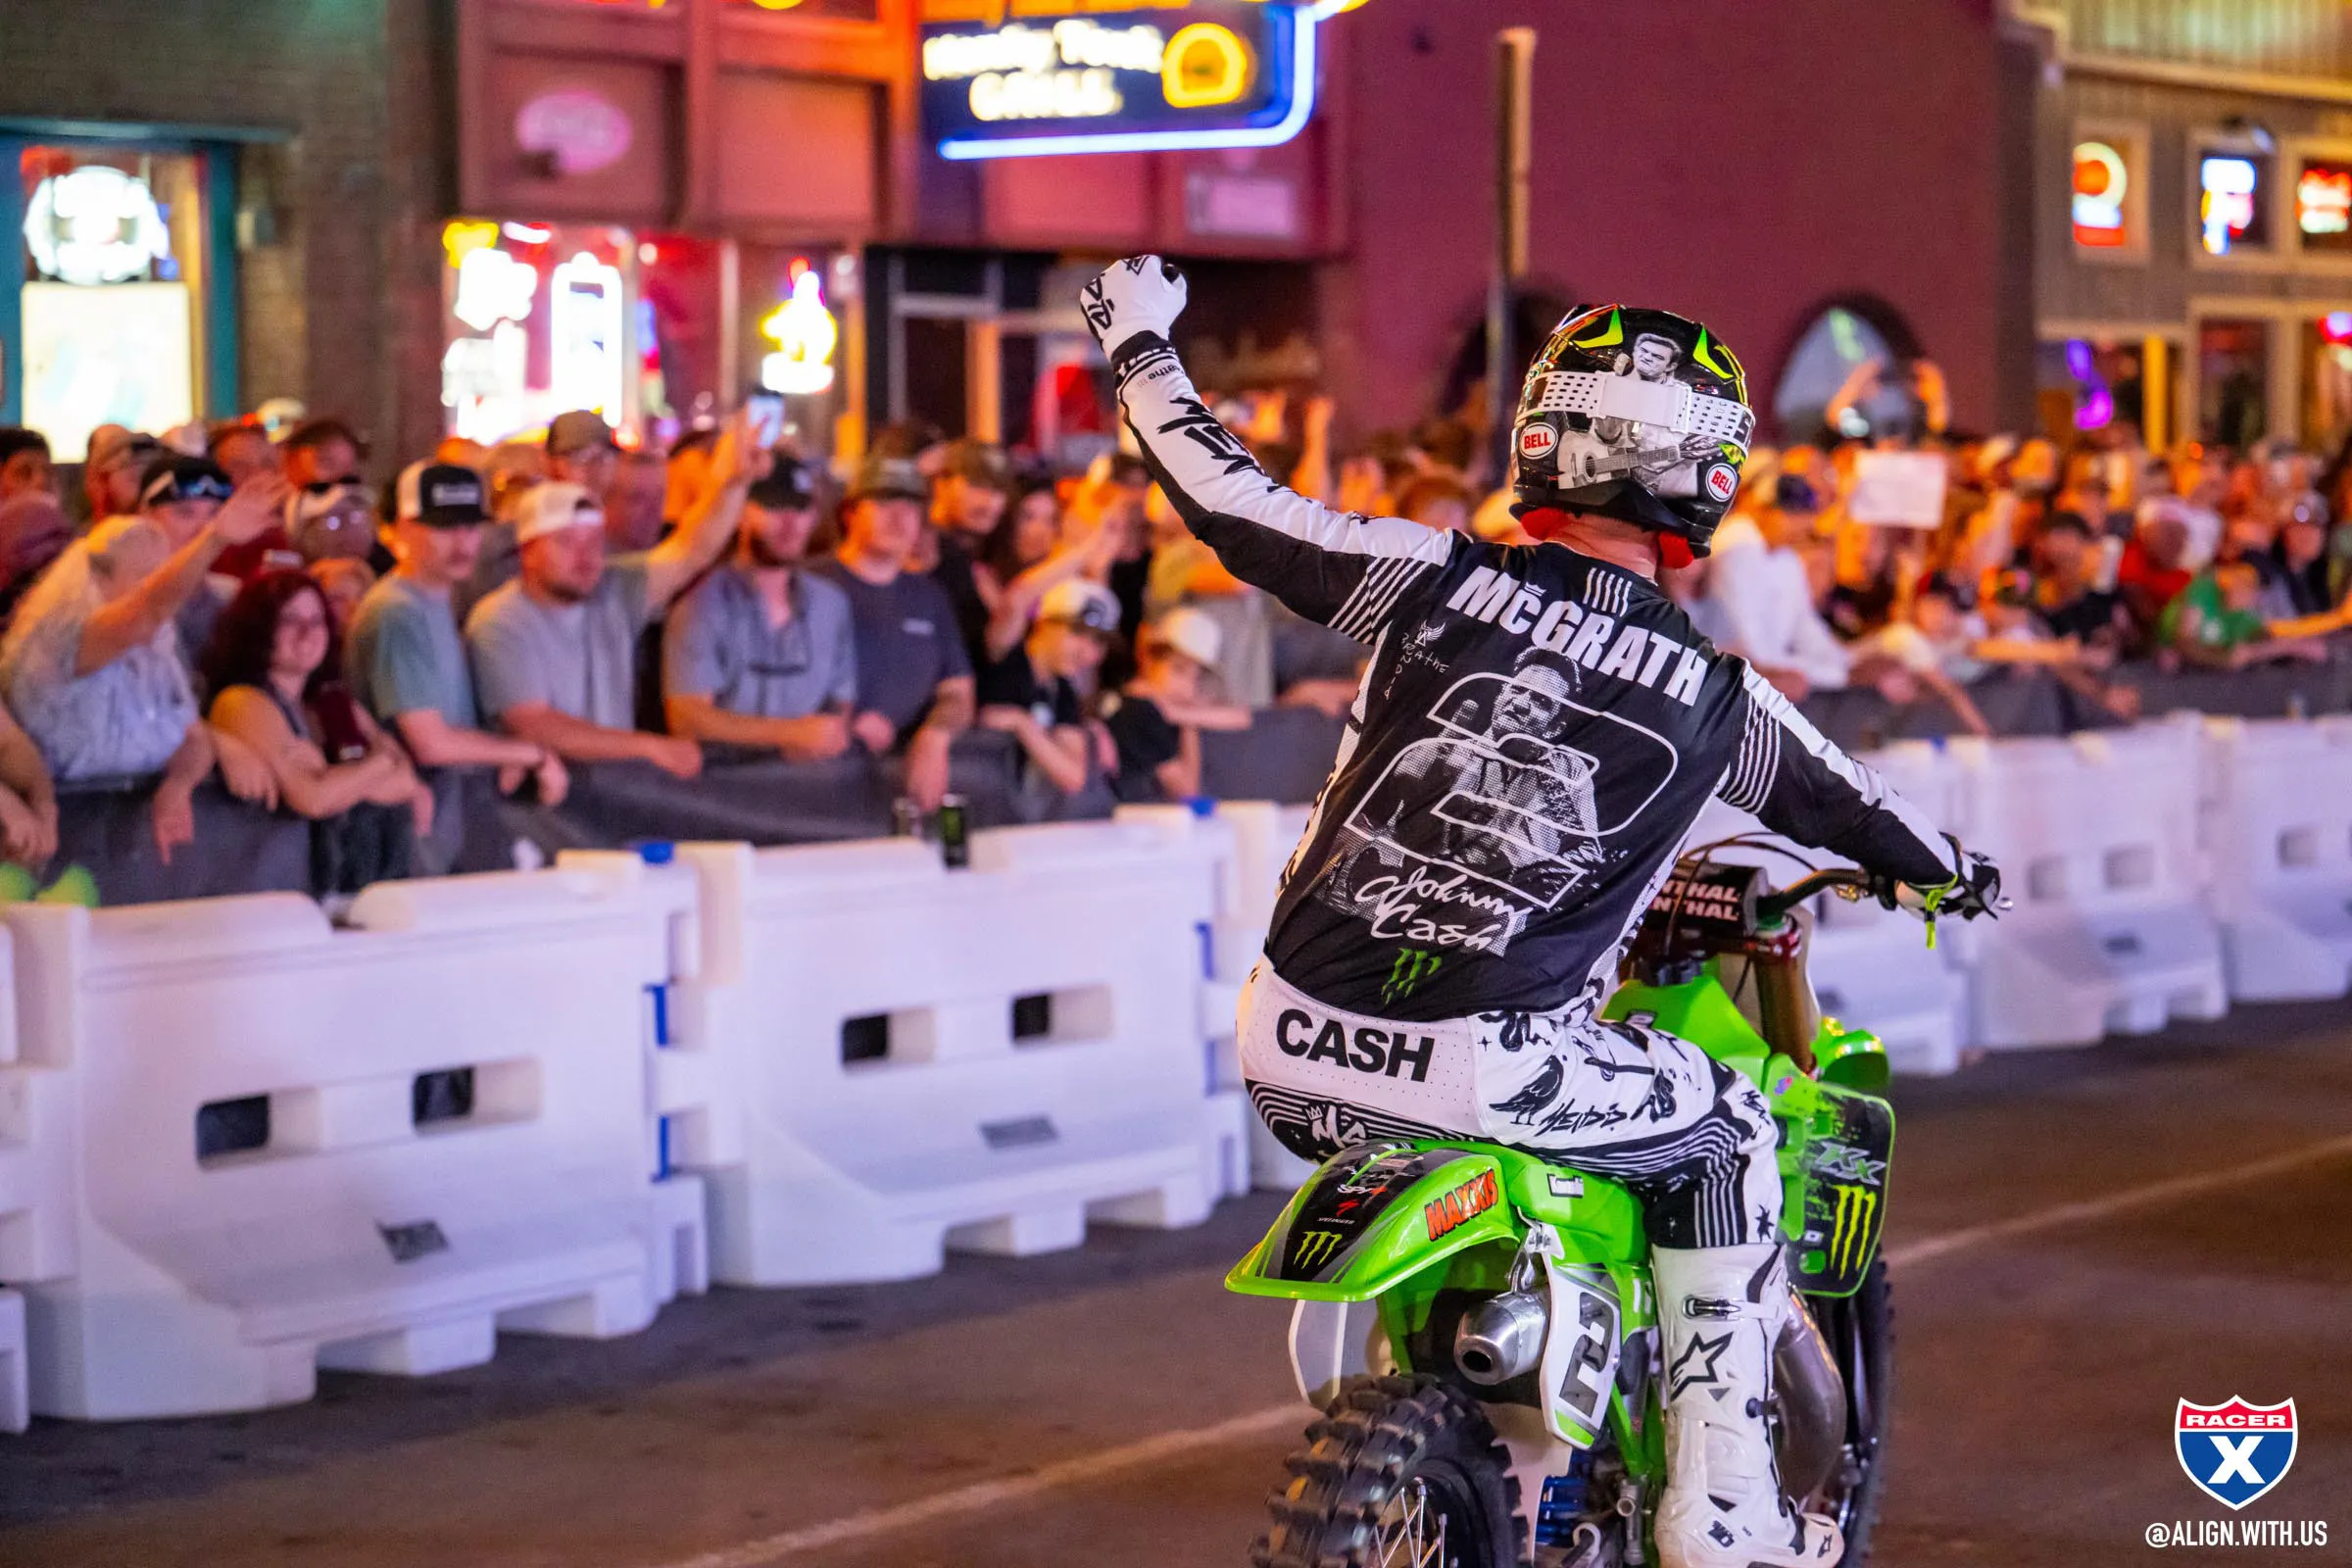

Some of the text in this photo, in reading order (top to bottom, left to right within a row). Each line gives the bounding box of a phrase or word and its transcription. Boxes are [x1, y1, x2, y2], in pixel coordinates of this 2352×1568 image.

[1523, 431, 1551, 450] BELL
[1710, 469, 1733, 495] BELL
[1354, 865, 1534, 940] Johnny
[1371, 903, 1502, 952] Cash
[1276, 1008, 1436, 1083] CASH
[1424, 1167, 1499, 1243] MAXXIS
